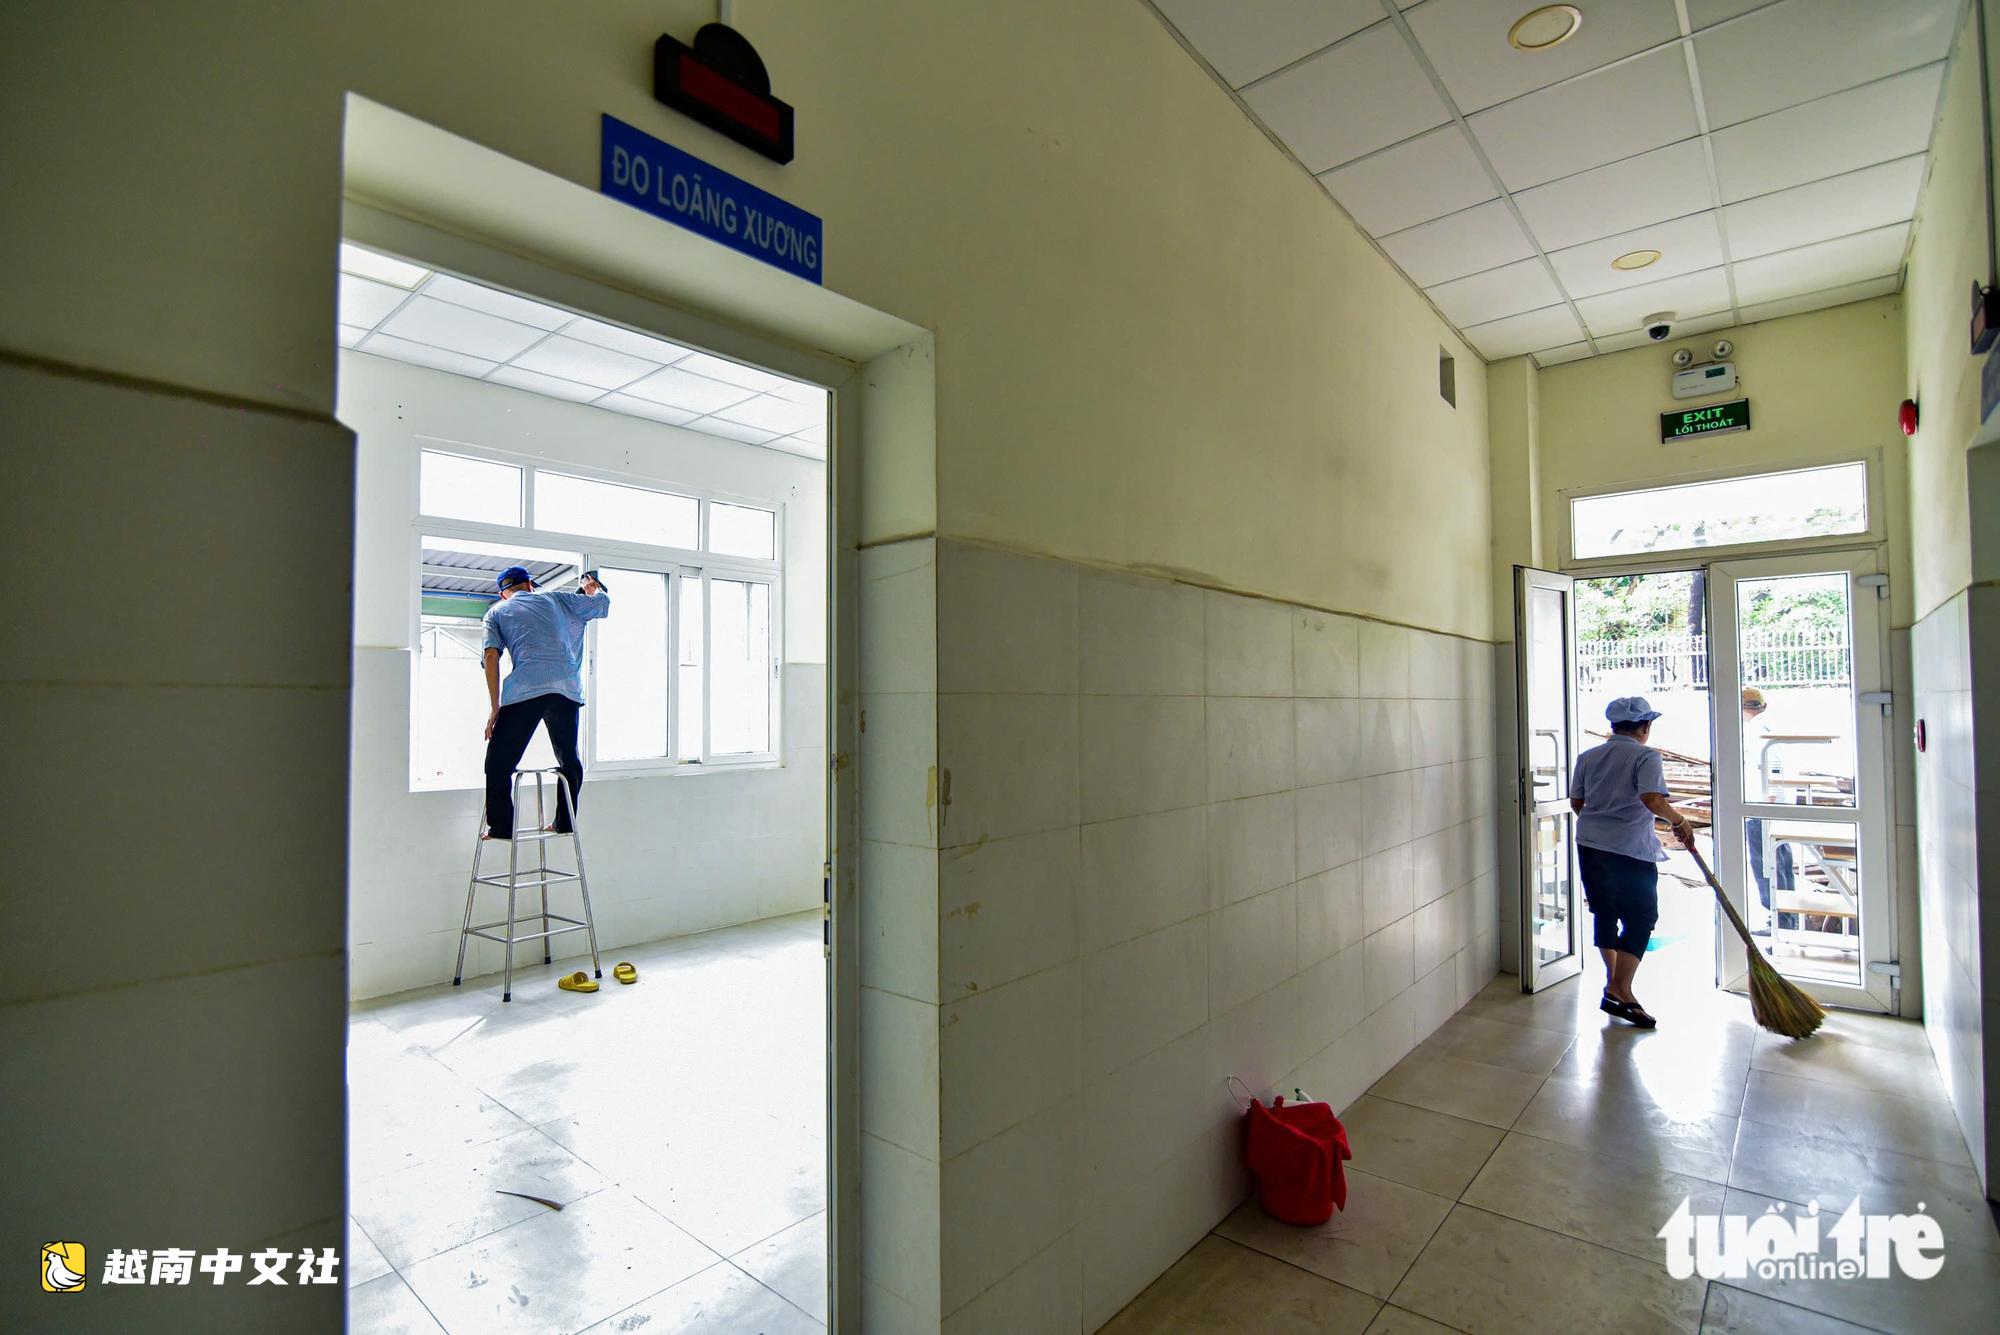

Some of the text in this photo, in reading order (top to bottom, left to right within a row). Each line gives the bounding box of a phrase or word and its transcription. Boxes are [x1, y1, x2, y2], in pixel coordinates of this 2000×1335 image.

[612, 146, 817, 269] ĐO LOÃNG XƯƠNG
[1683, 408, 1724, 423] EXIT
[1696, 418, 1734, 432] THOÁT
